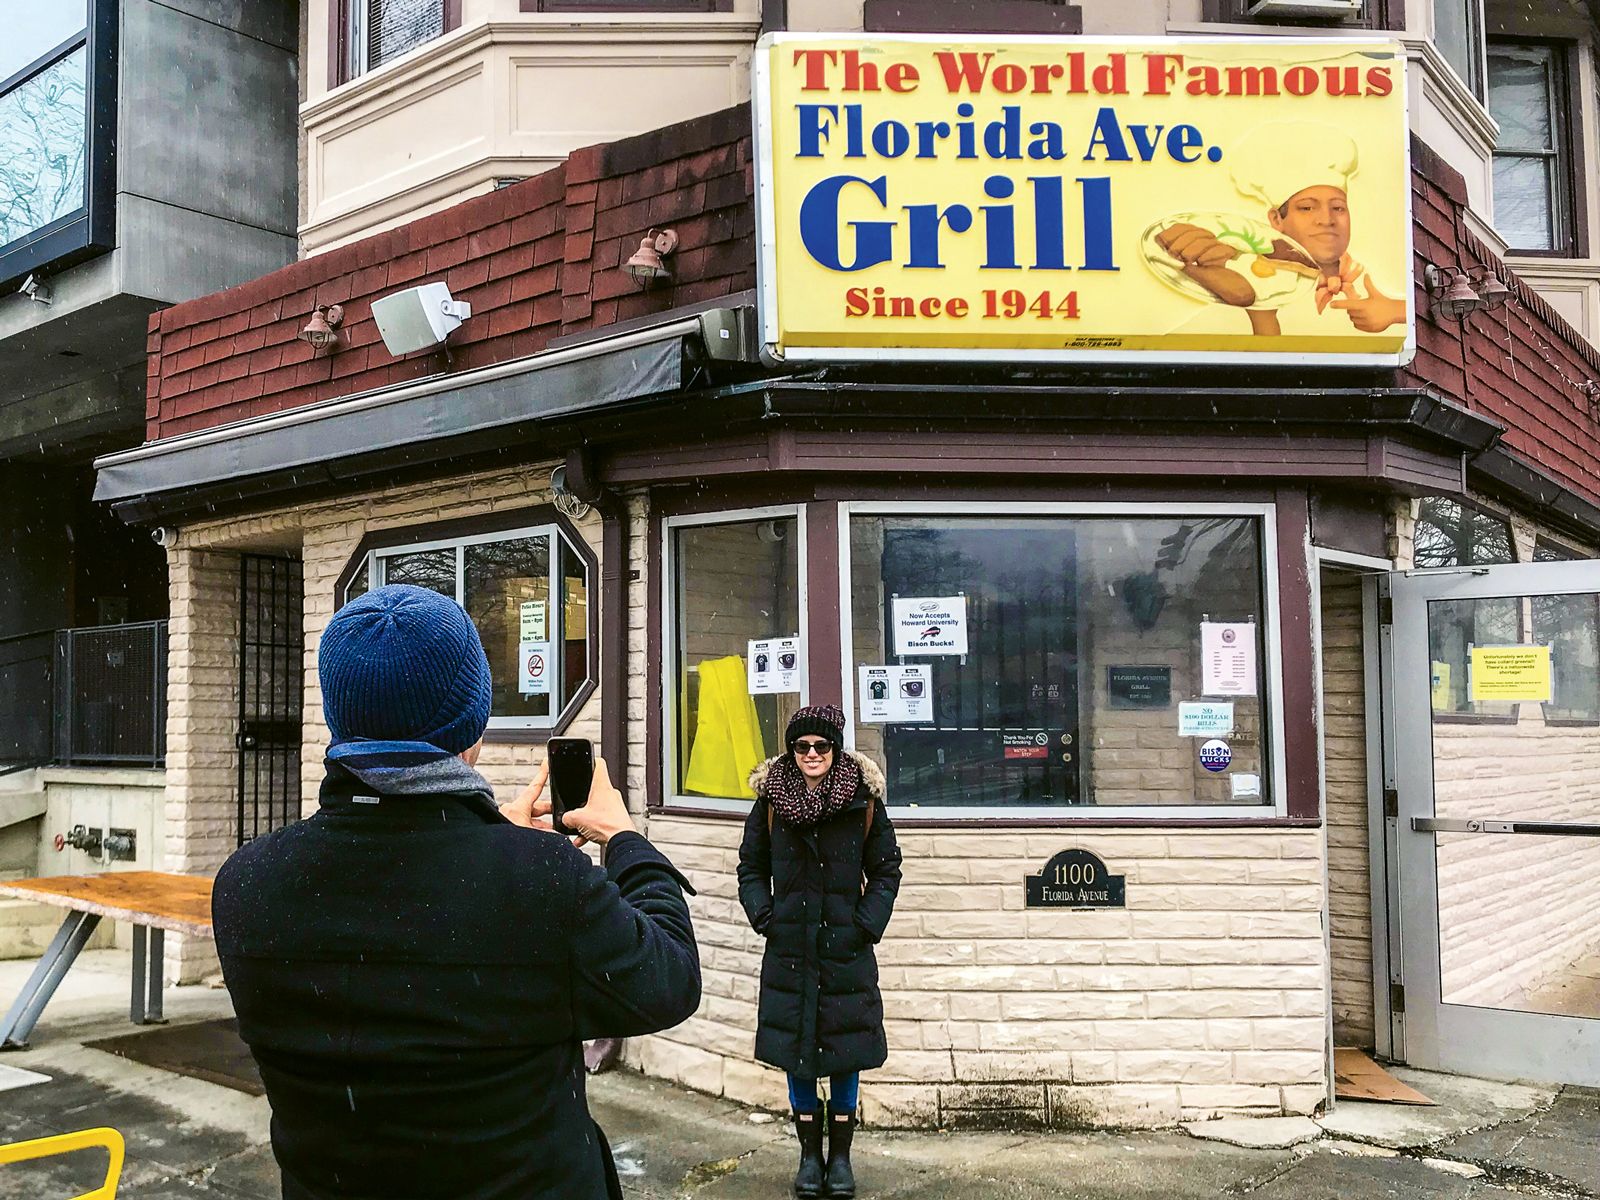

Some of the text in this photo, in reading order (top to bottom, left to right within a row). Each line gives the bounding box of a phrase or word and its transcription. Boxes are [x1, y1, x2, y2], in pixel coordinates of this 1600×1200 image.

[793, 50, 1393, 97] The World Famous
[794, 102, 1223, 163] Florida Ave.
[799, 175, 1121, 272] Grill
[845, 286, 1081, 319] Since 1944
[925, 612, 950, 620] Accepts
[1202, 747, 1230, 756] BISON
[1054, 863, 1095, 885] 1100
